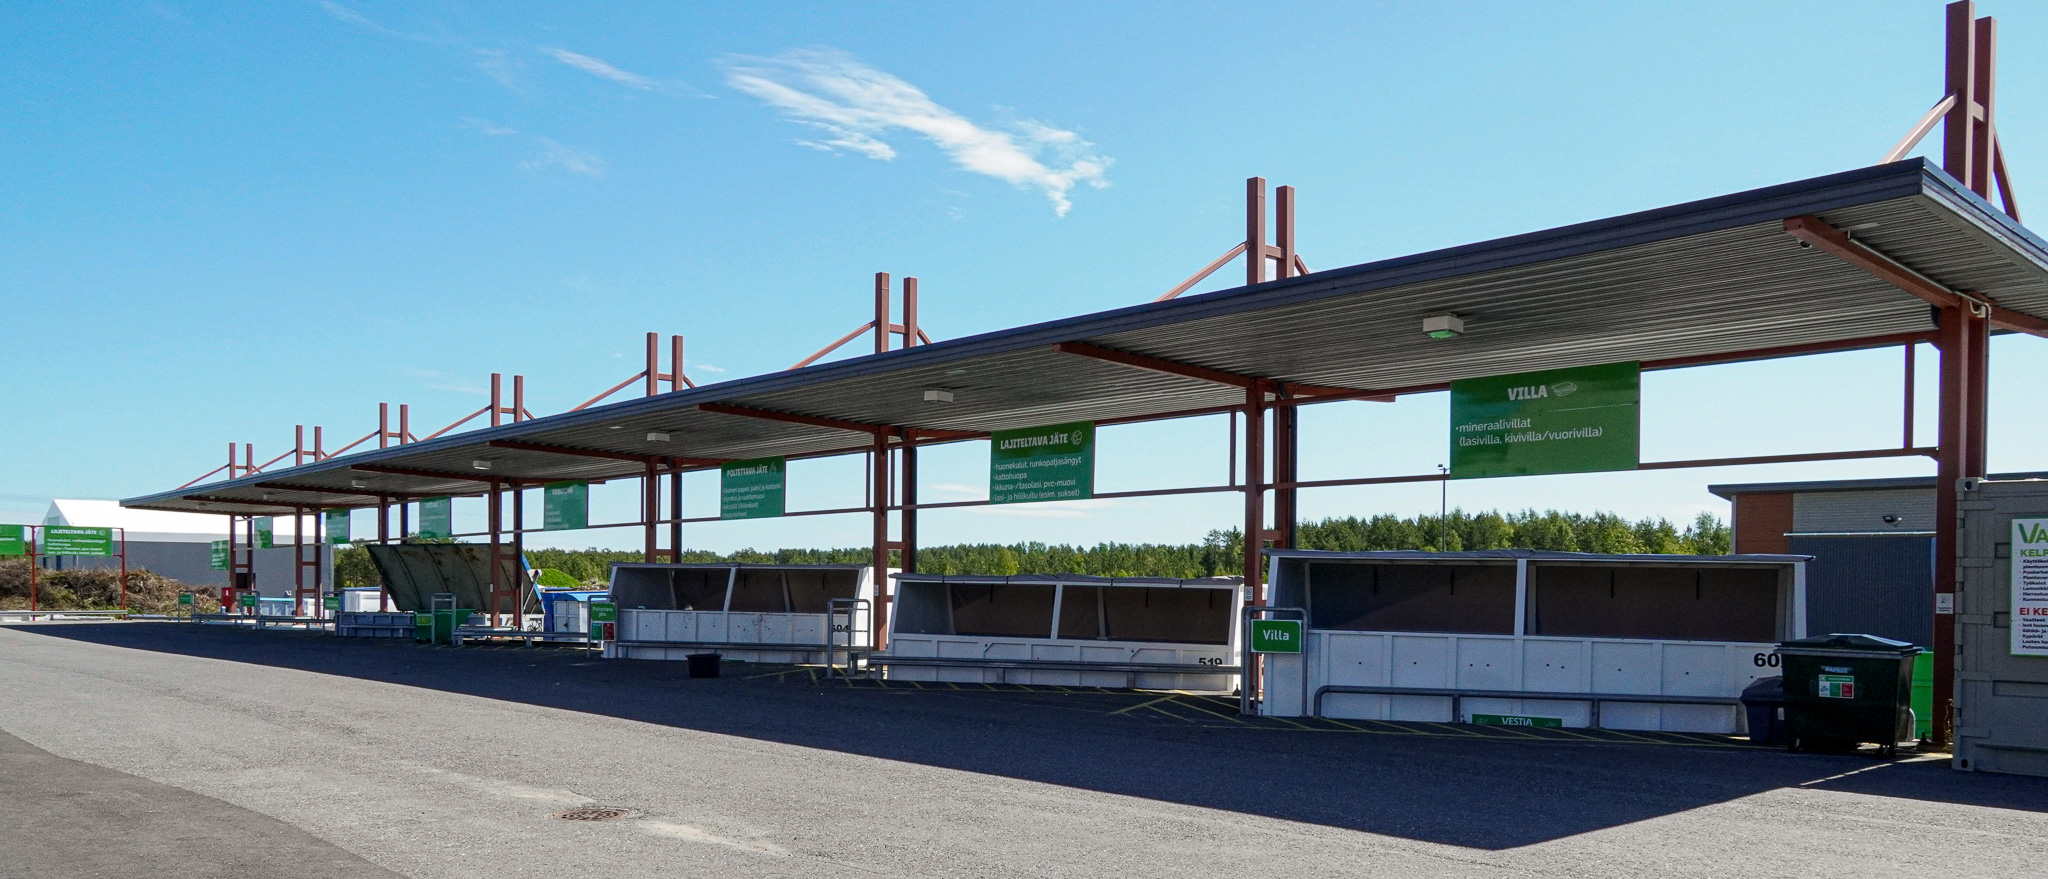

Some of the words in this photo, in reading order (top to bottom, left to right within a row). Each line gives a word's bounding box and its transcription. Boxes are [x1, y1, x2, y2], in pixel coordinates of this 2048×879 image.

[1507, 384, 1548, 401] VILLA
[1000, 435, 1048, 450] LAJITELTAVA
[1049, 432, 1069, 445] JÄTE
[1504, 426, 1603, 443] kivivilla/vuorivilla)
[2019, 607, 2030, 616] EI
[1262, 629, 1290, 641] Villa
[1501, 716, 1533, 726] VESTIA
